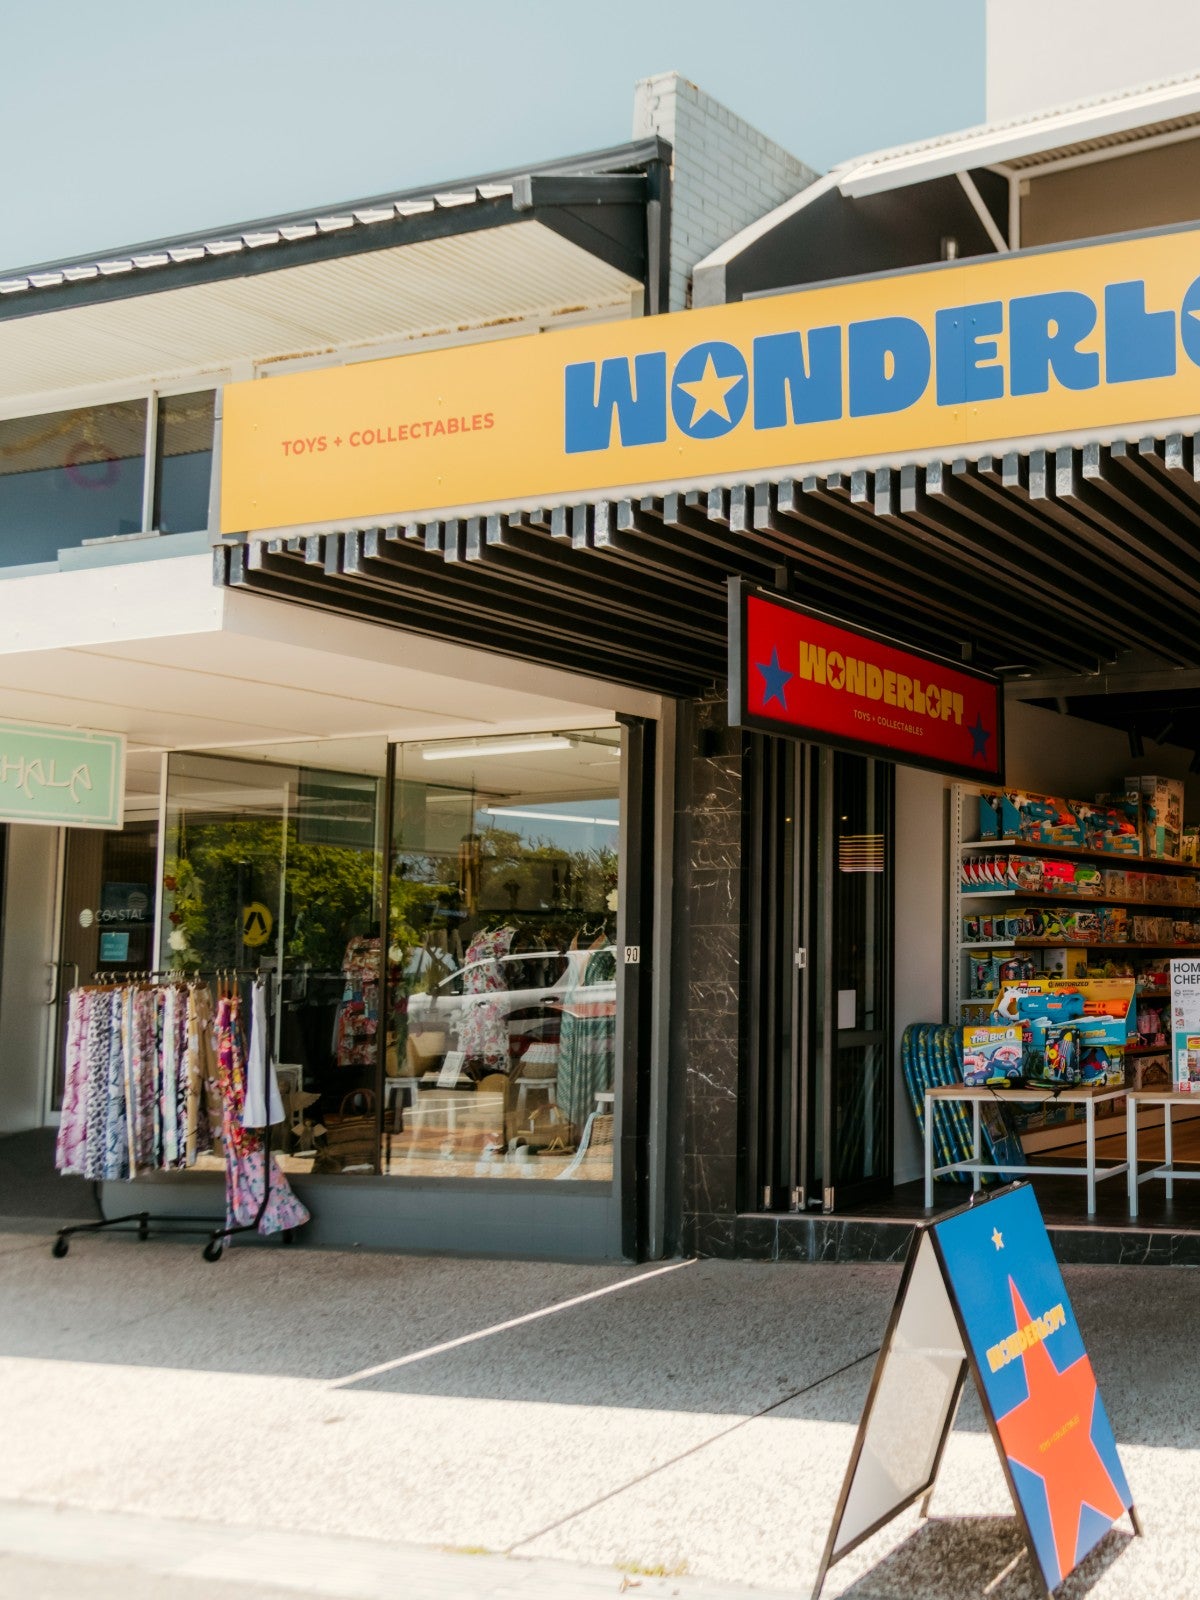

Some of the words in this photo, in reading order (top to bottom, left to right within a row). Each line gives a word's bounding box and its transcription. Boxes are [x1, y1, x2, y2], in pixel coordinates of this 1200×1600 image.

[281, 436, 328, 457] TOYS
[333, 436, 343, 447] +
[349, 412, 495, 448] COLLECTABLES
[799, 640, 964, 725] WONDERLOFT
[853, 709, 871, 722] TOYS
[877, 716, 924, 736] COLLECTABLES
[0, 753, 93, 804] HALA
[95, 908, 145, 921] COASTAL
[626, 947, 638, 962] 90
[970, 1034, 988, 1045] THE
[988, 1032, 1004, 1042] BIG
